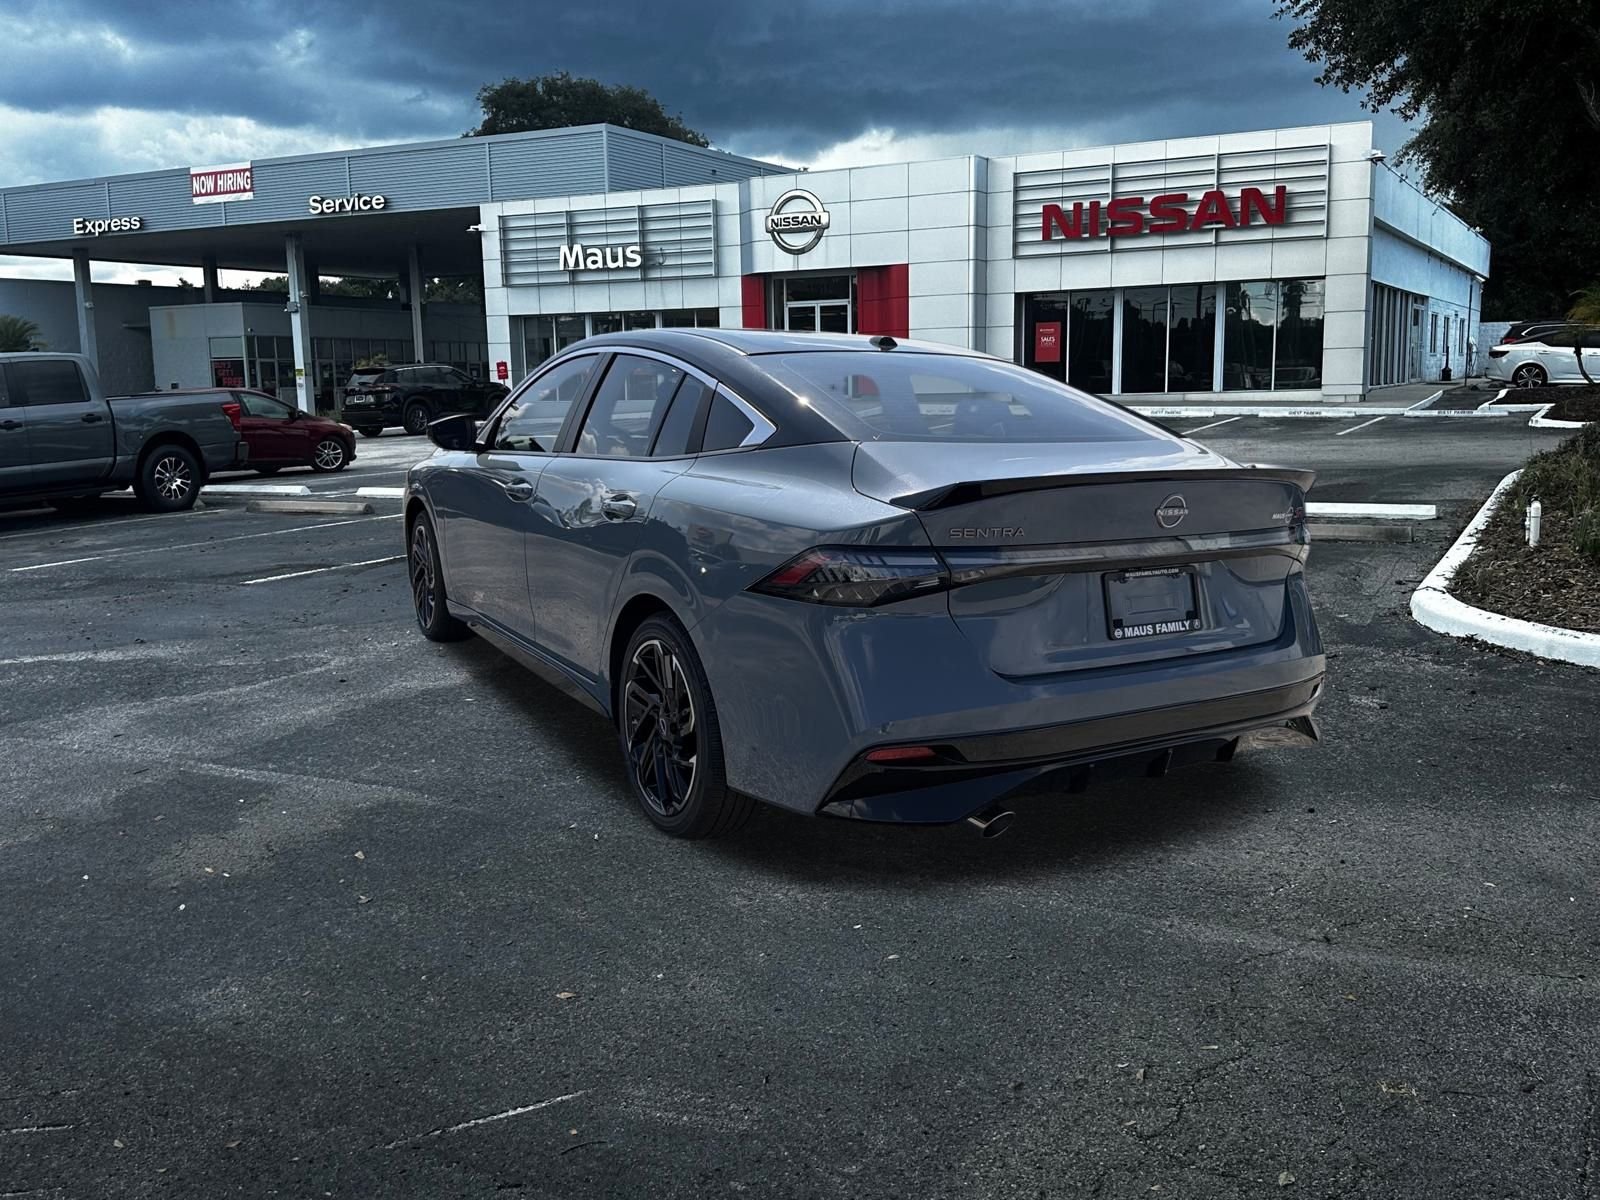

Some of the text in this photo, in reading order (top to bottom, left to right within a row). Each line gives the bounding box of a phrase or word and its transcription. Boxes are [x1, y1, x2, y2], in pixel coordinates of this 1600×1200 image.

[192, 171, 251, 195] NOW HIRING
[308, 193, 385, 215] Service
[1042, 185, 1287, 241] NISSAN
[73, 216, 141, 237] Express
[770, 214, 823, 230] NISSAN
[559, 244, 642, 271] Maus
[223, 377, 243, 385] FREE
[1156, 508, 1189, 516] NISSAN
[950, 527, 1025, 539] SENTRA
[1124, 620, 1190, 638] MAUS FAMILY
